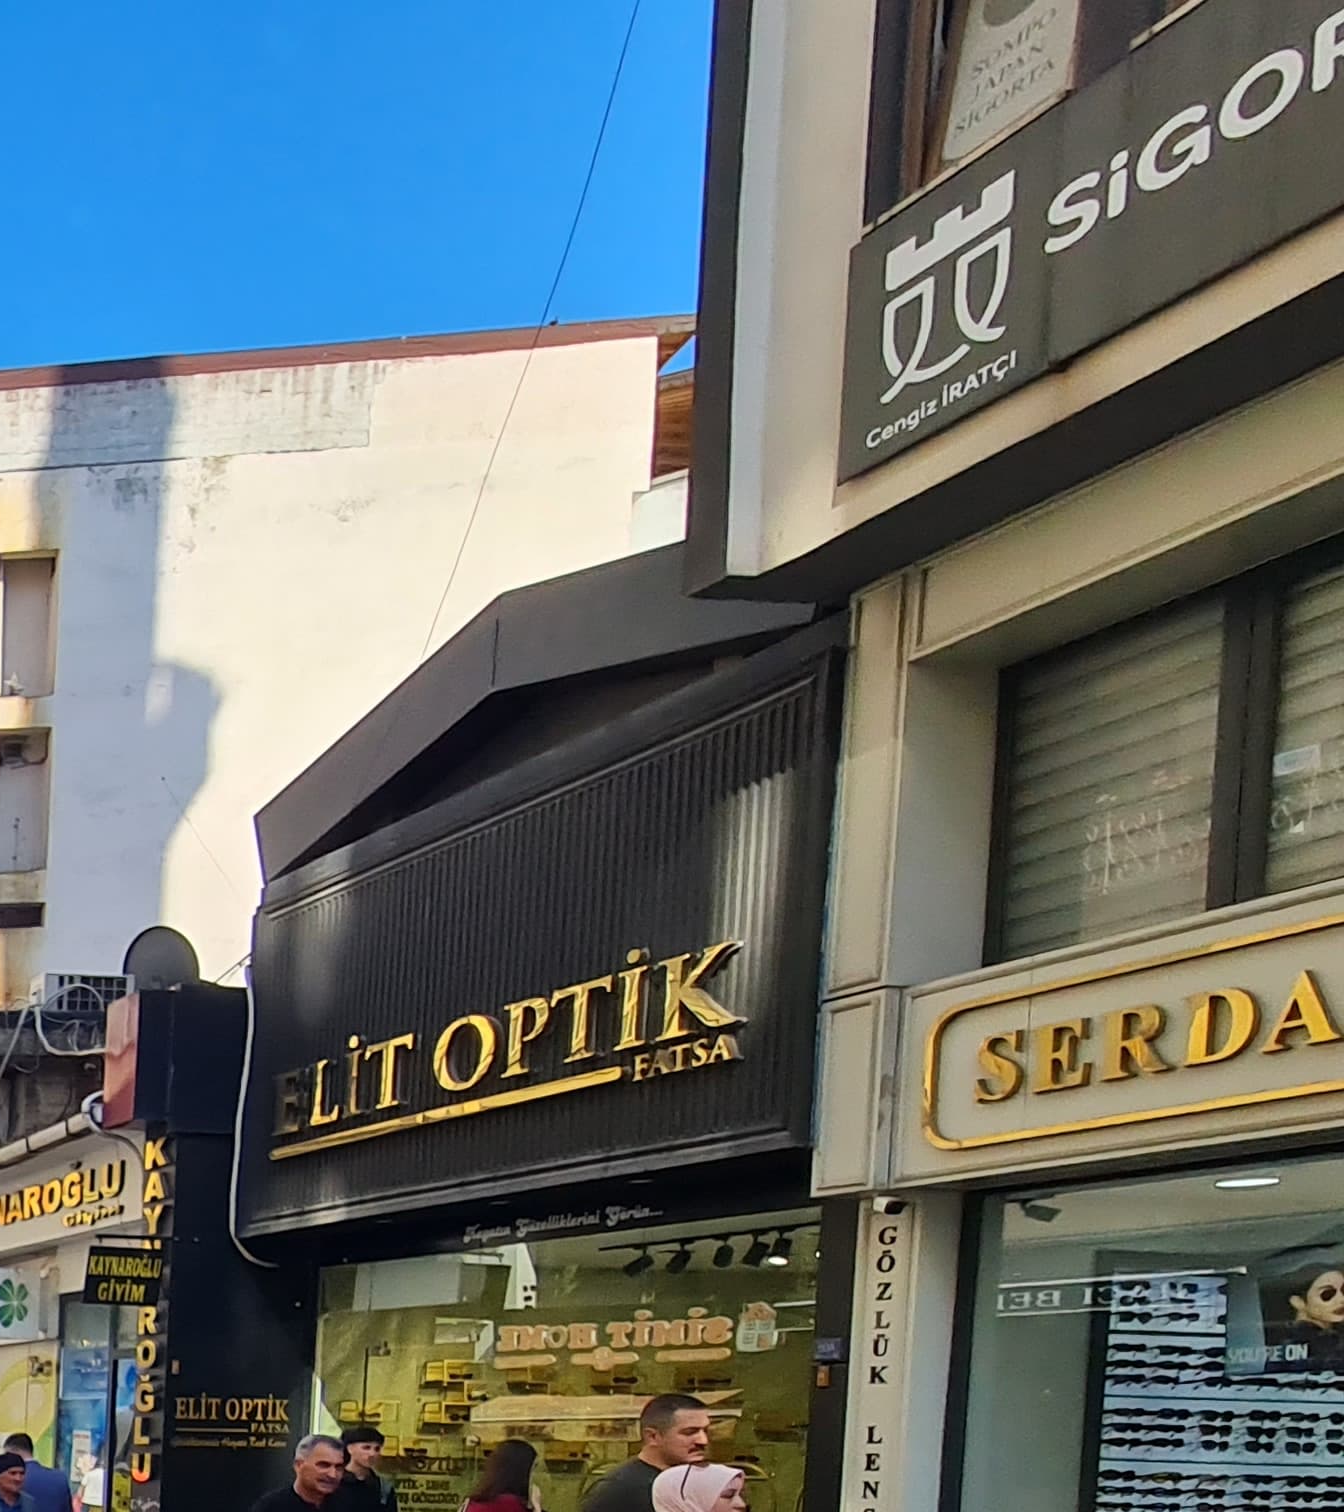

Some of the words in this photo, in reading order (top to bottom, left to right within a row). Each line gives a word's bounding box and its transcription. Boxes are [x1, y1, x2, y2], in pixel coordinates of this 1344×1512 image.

[972, 7, 1057, 79] SOMPO
[973, 46, 1042, 99] JAPAN
[865, 398, 938, 448] Cengiz
[941, 350, 1017, 407] İRATÇI
[272, 1035, 419, 1136] ELİT
[432, 940, 749, 1092] OPTİK
[631, 1033, 746, 1083] FATSA
[88, 1254, 162, 1279] KAYNAROĞLU
[97, 1278, 147, 1303] GİYİM
[131, 1137, 168, 1483] KAYROĞLU
[868, 1225, 898, 1386] GÖZLÜK
[1285, 1343, 1308, 1361] ON
[175, 1392, 221, 1421] ELİT
[225, 1392, 289, 1421] OPTİK
